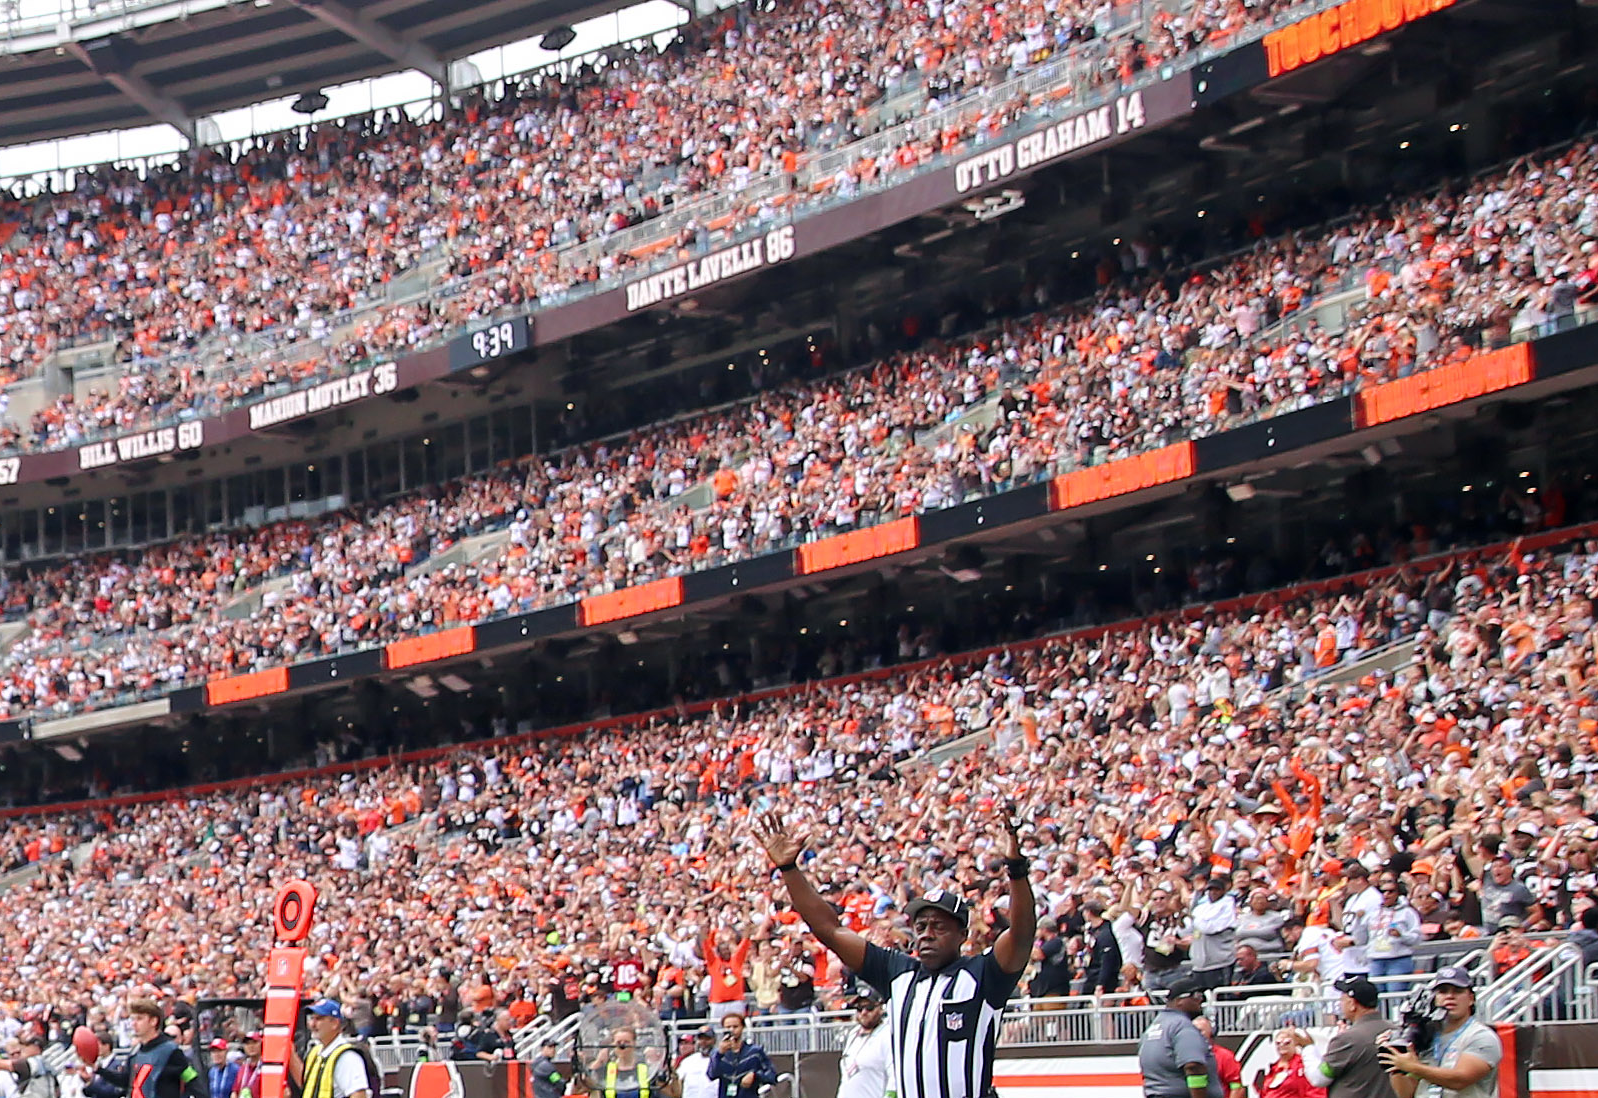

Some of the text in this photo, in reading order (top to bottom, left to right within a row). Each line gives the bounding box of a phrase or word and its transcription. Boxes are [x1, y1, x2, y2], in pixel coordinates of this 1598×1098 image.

[955, 90, 1146, 193] OTTO GRAHAM 14
[626, 225, 795, 312] DANTE LAVELLI 86
[471, 322, 514, 359] 9:39
[249, 391, 306, 430] MARION
[372, 361, 399, 395] 36
[79, 420, 203, 470] BILL WILLIS 60
